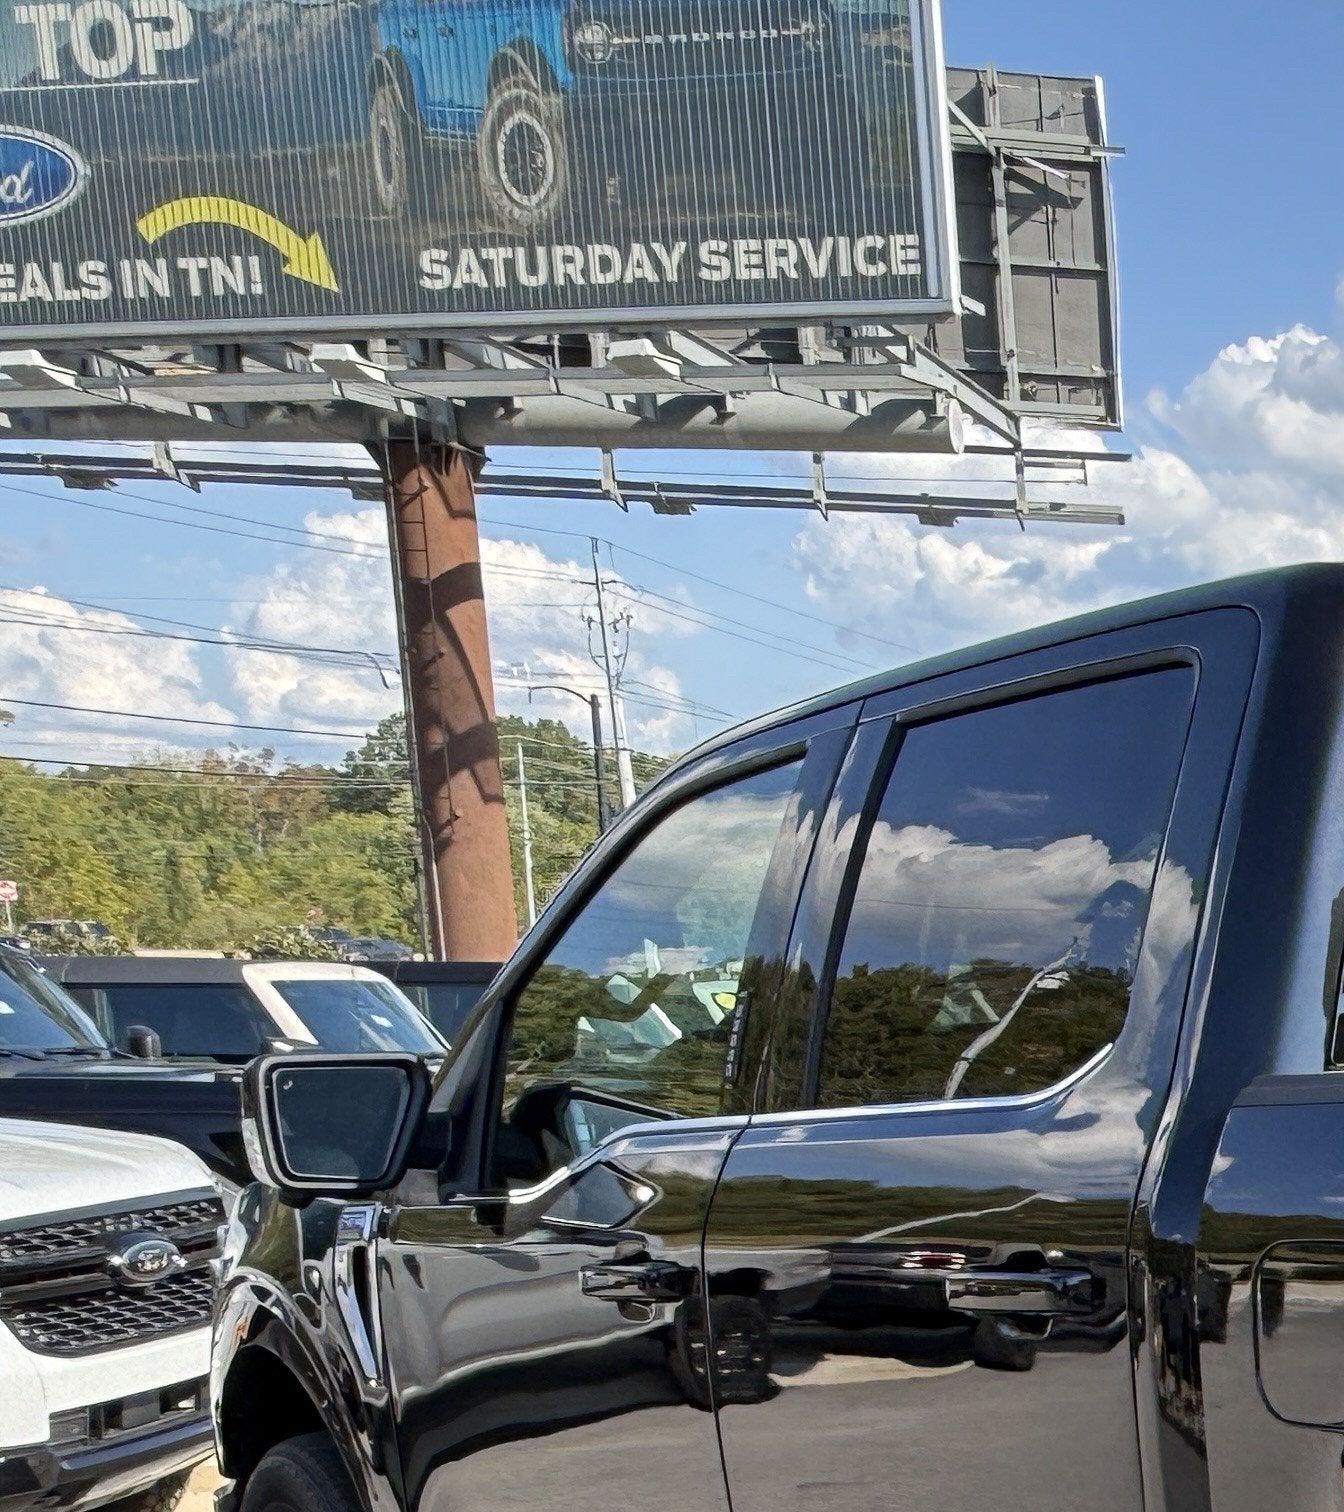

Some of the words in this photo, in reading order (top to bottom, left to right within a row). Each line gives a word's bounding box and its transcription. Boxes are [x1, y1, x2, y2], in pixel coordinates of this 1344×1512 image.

[15, 0, 194, 81] TOP
[119, 257, 171, 298] IN
[177, 255, 263, 295] TN!
[419, 241, 687, 290] SATURDAY
[698, 234, 921, 281] SERVICE
